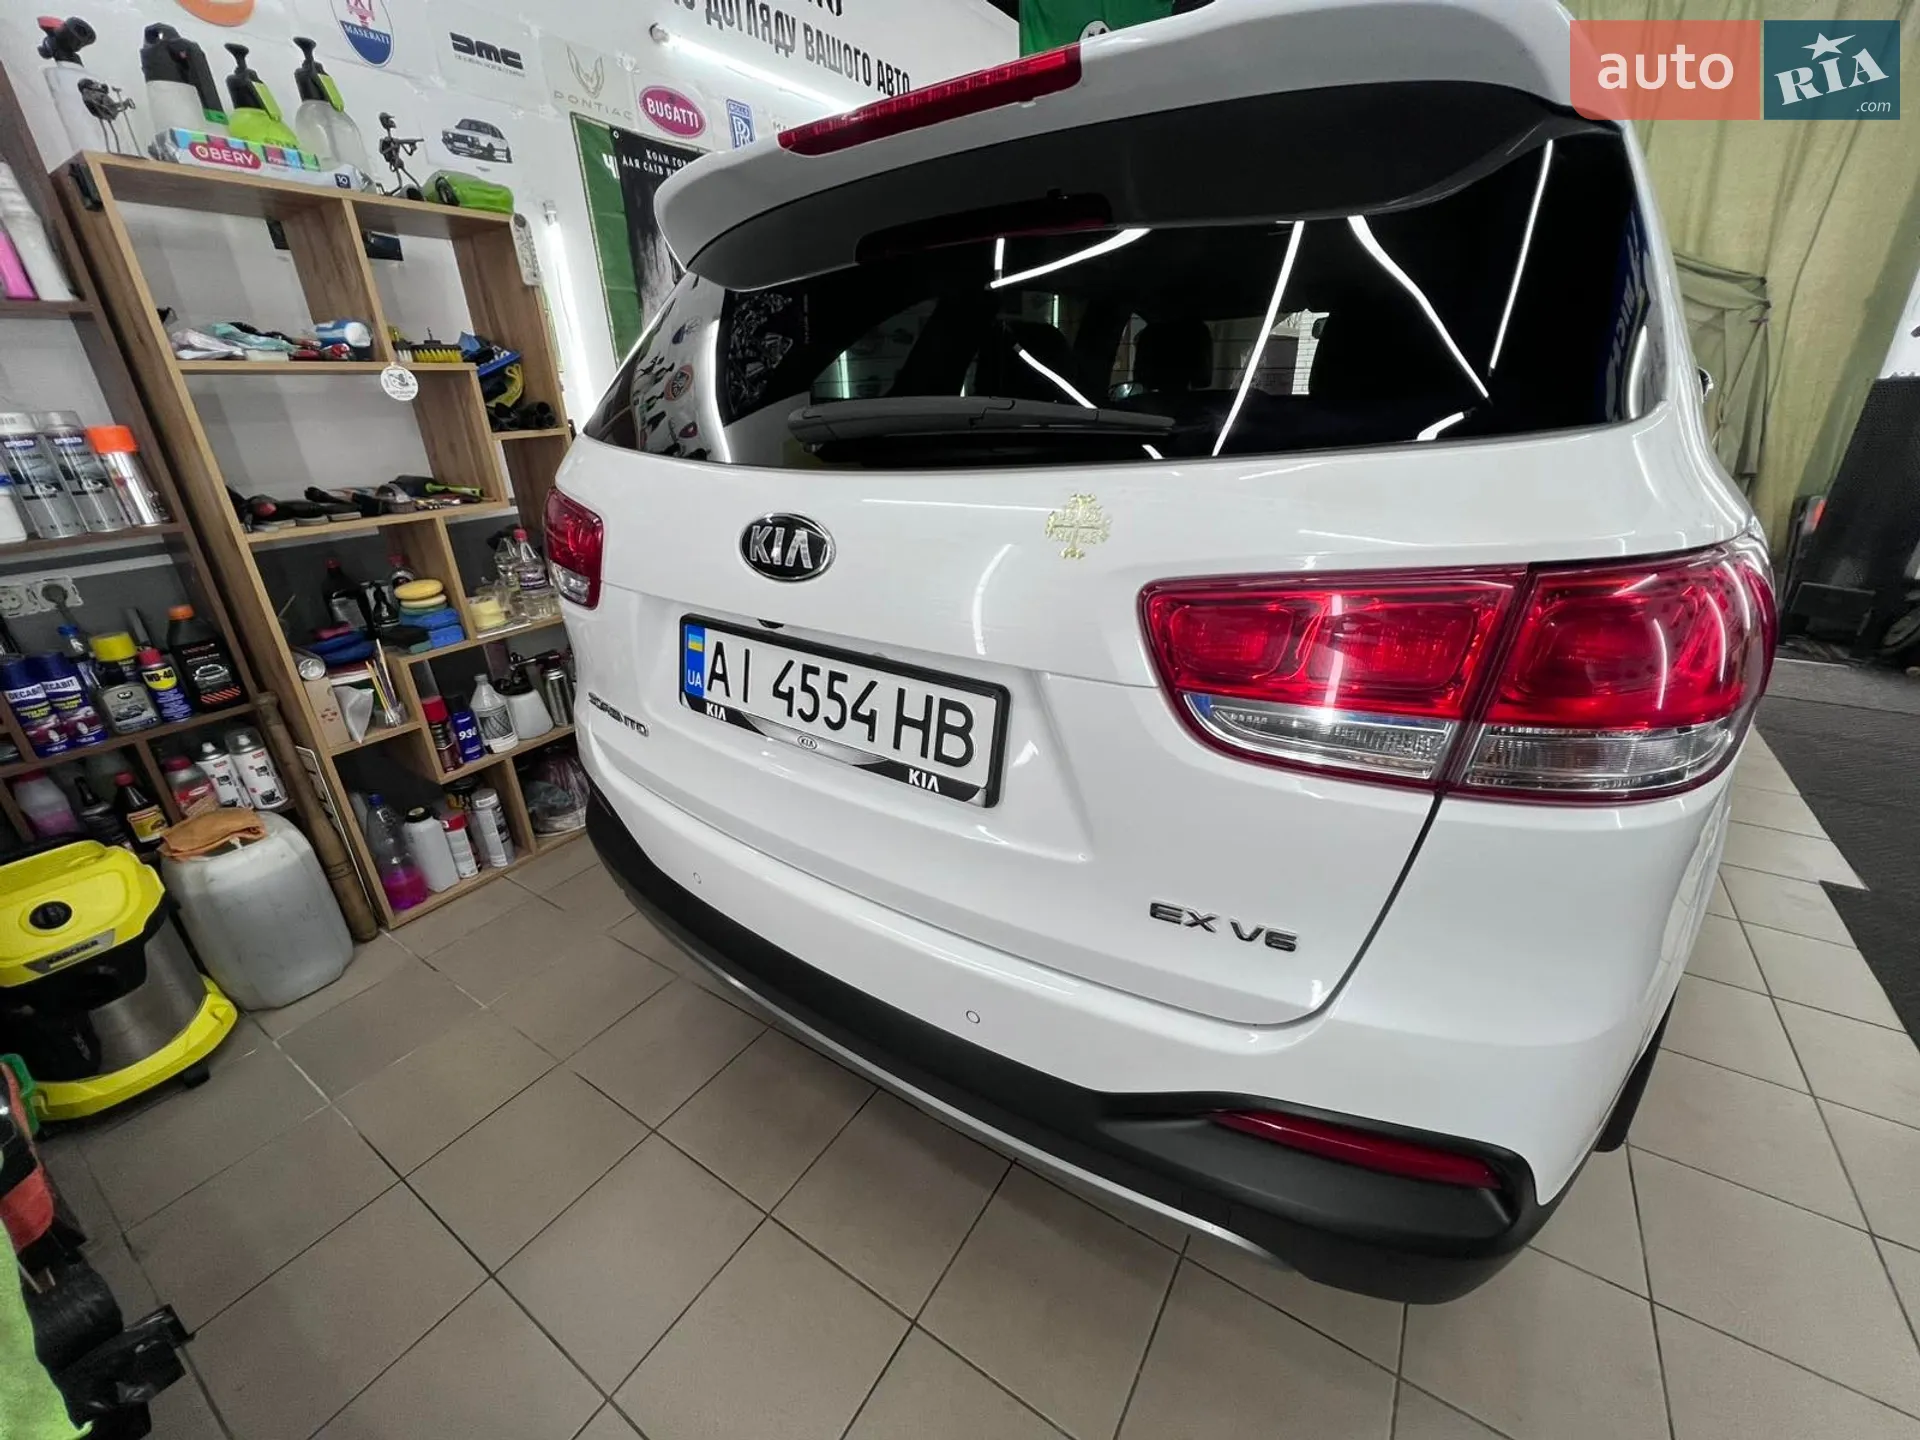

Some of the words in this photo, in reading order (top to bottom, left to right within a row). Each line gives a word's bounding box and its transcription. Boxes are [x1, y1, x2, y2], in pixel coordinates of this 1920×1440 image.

[344, 24, 391, 45] MASERATI
[803, 22, 872, 87] ВАШОГО
[554, 90, 634, 121] PONTIAC
[647, 97, 699, 129] BUGATTI
[195, 145, 254, 166] OBERY
[750, 525, 813, 569] KIA
[687, 669, 703, 688] UA
[706, 702, 727, 721] KIA
[707, 641, 751, 703] AI
[772, 659, 878, 743] 4554
[893, 687, 974, 768] HB
[800, 736, 814, 747] KIA
[908, 768, 939, 792] KIA
[1150, 902, 1217, 933] EX
[1230, 921, 1297, 952] V6
